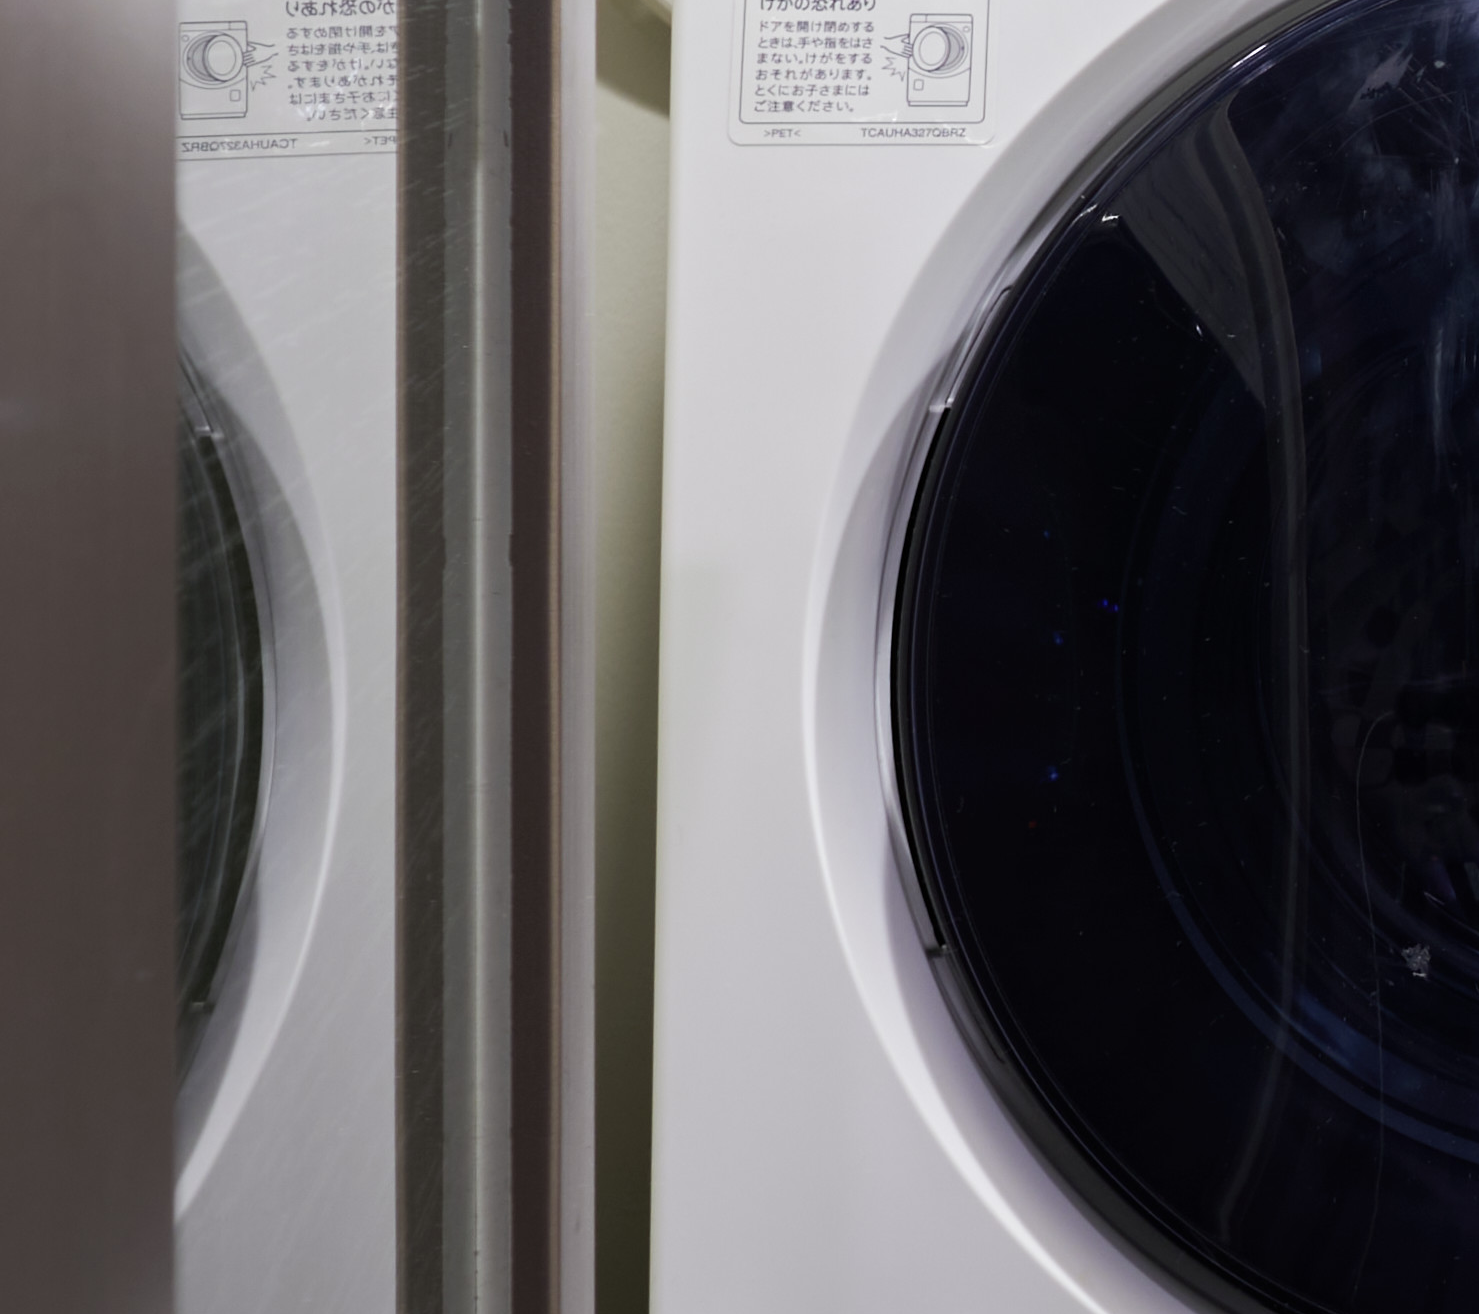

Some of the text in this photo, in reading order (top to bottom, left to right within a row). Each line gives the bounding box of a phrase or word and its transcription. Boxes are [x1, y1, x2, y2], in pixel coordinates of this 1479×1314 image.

[759, 20, 875, 34] ドアを開け閉めする
[755, 68, 872, 81] おそれがあります。
[754, 83, 869, 97] とくにお子さまには
[754, 99, 856, 113] ご注意ください。
